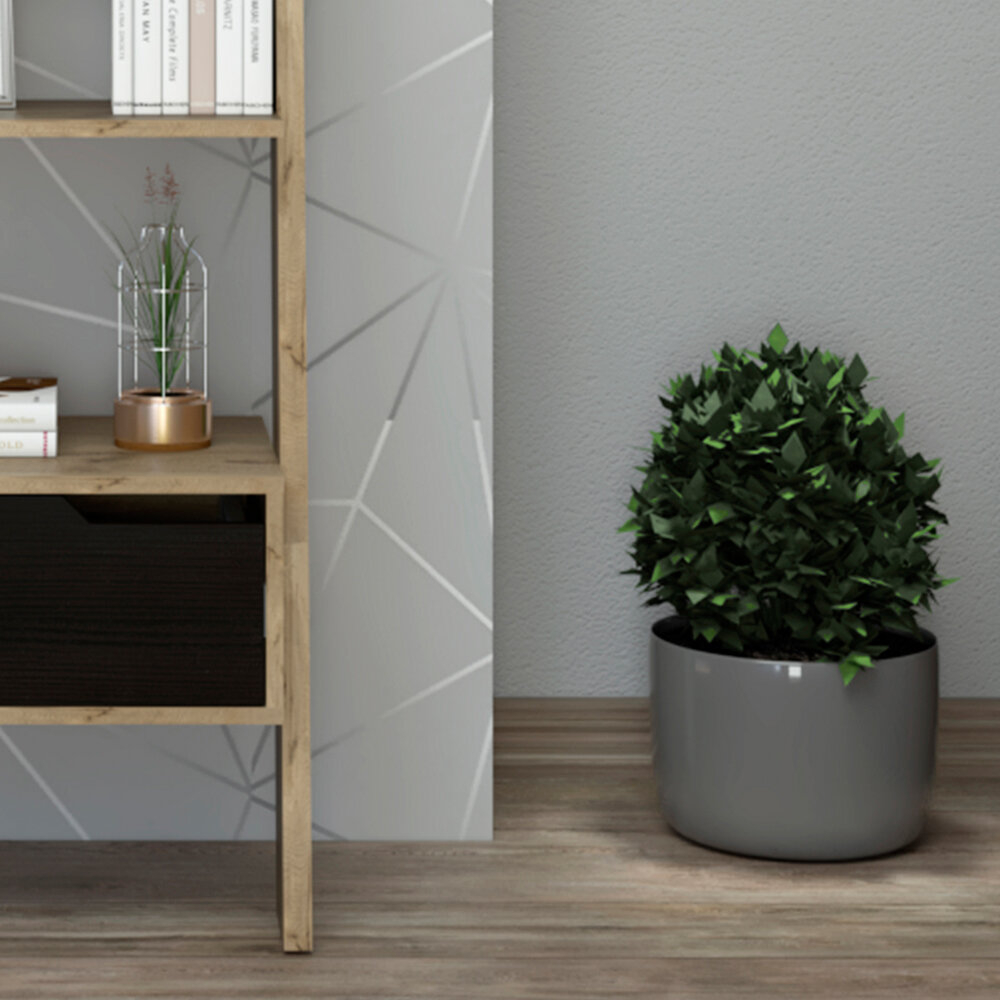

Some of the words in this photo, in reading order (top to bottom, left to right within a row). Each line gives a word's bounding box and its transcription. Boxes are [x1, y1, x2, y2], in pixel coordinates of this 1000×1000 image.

[142, 20, 150, 43] MAY
[167, 7, 178, 53] Complete
[169, 56, 178, 82] Films
